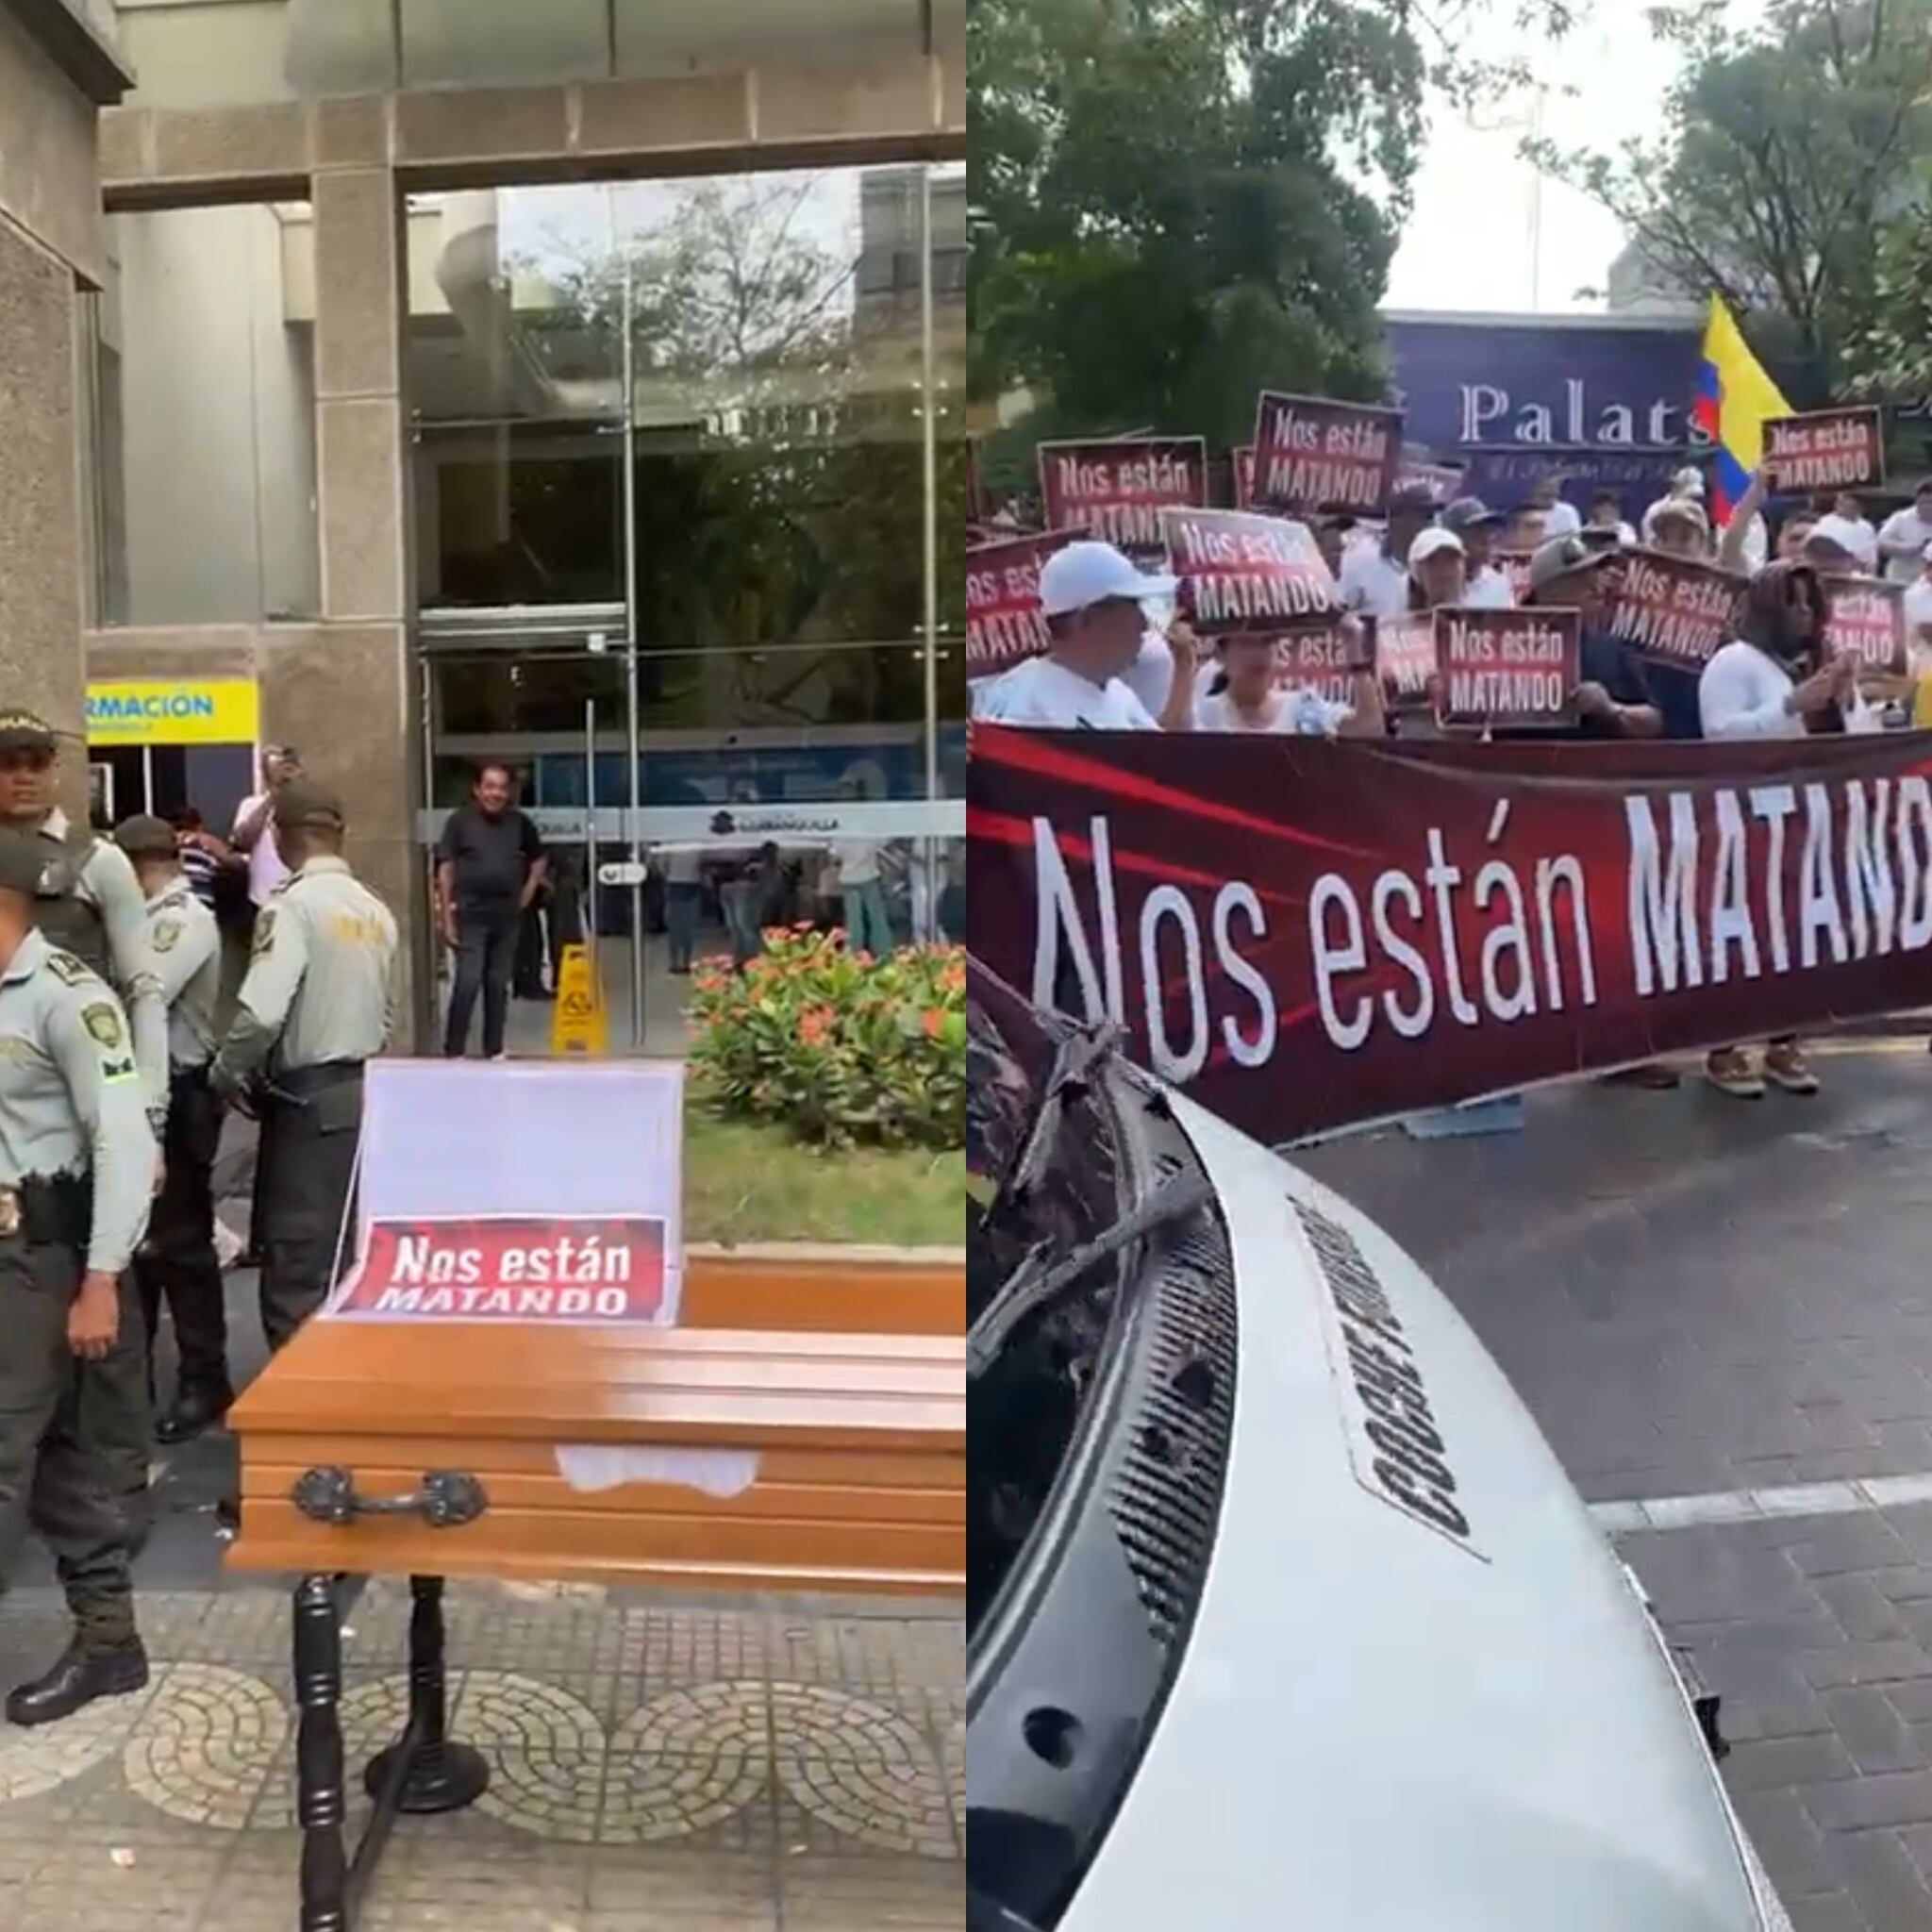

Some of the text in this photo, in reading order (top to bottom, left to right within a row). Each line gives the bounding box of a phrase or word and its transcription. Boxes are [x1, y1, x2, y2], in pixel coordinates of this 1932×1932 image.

[1274, 407, 1387, 461] Nos están
[1058, 453, 1189, 497] Nos están
[1267, 455, 1381, 507] MATANDO
[966, 571, 997, 607] os
[1194, 572, 1328, 621] MATANDO
[1622, 558, 1670, 601] Nos
[1449, 619, 1494, 660] Nos
[1501, 620, 1562, 662] están
[1609, 601, 1723, 660] MATANDO
[1450, 667, 1563, 713] MATANDO
[1032, 815, 1277, 1084] Nos
[1308, 798, 1597, 1050] están
[391, 1234, 631, 1284] Nos están
[374, 1286, 628, 1317] MATANDO
